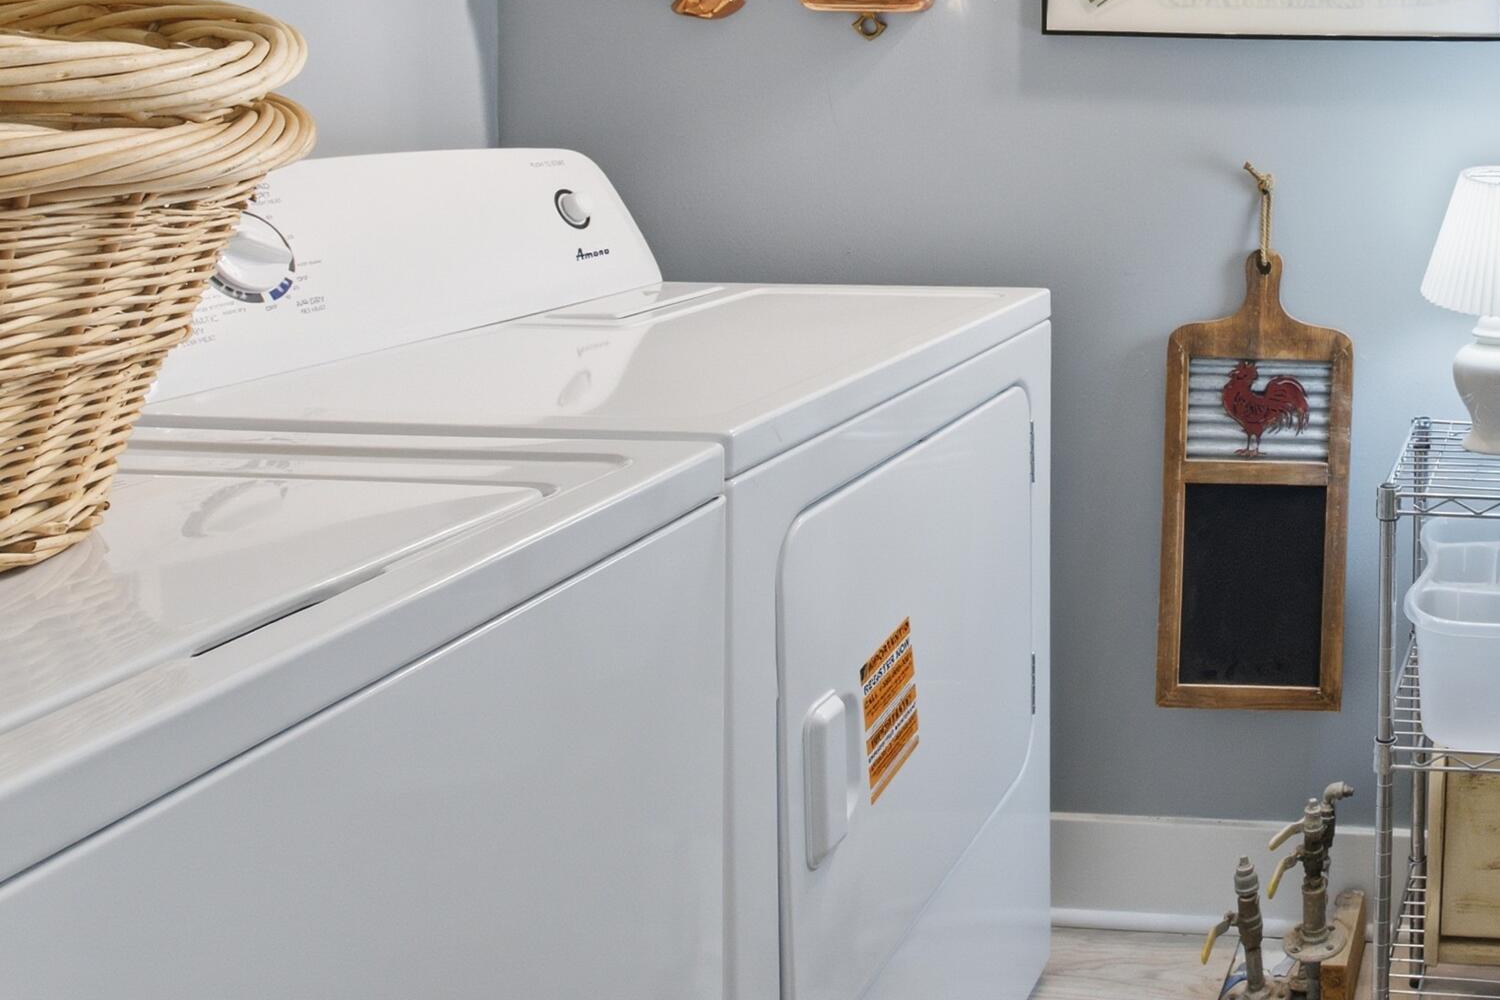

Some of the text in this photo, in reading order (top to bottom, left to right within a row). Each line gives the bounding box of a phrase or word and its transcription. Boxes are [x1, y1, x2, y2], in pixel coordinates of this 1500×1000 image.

[576, 247, 610, 261] Amana
[863, 654, 895, 696] REGISTER
[895, 639, 910, 658] NOW
